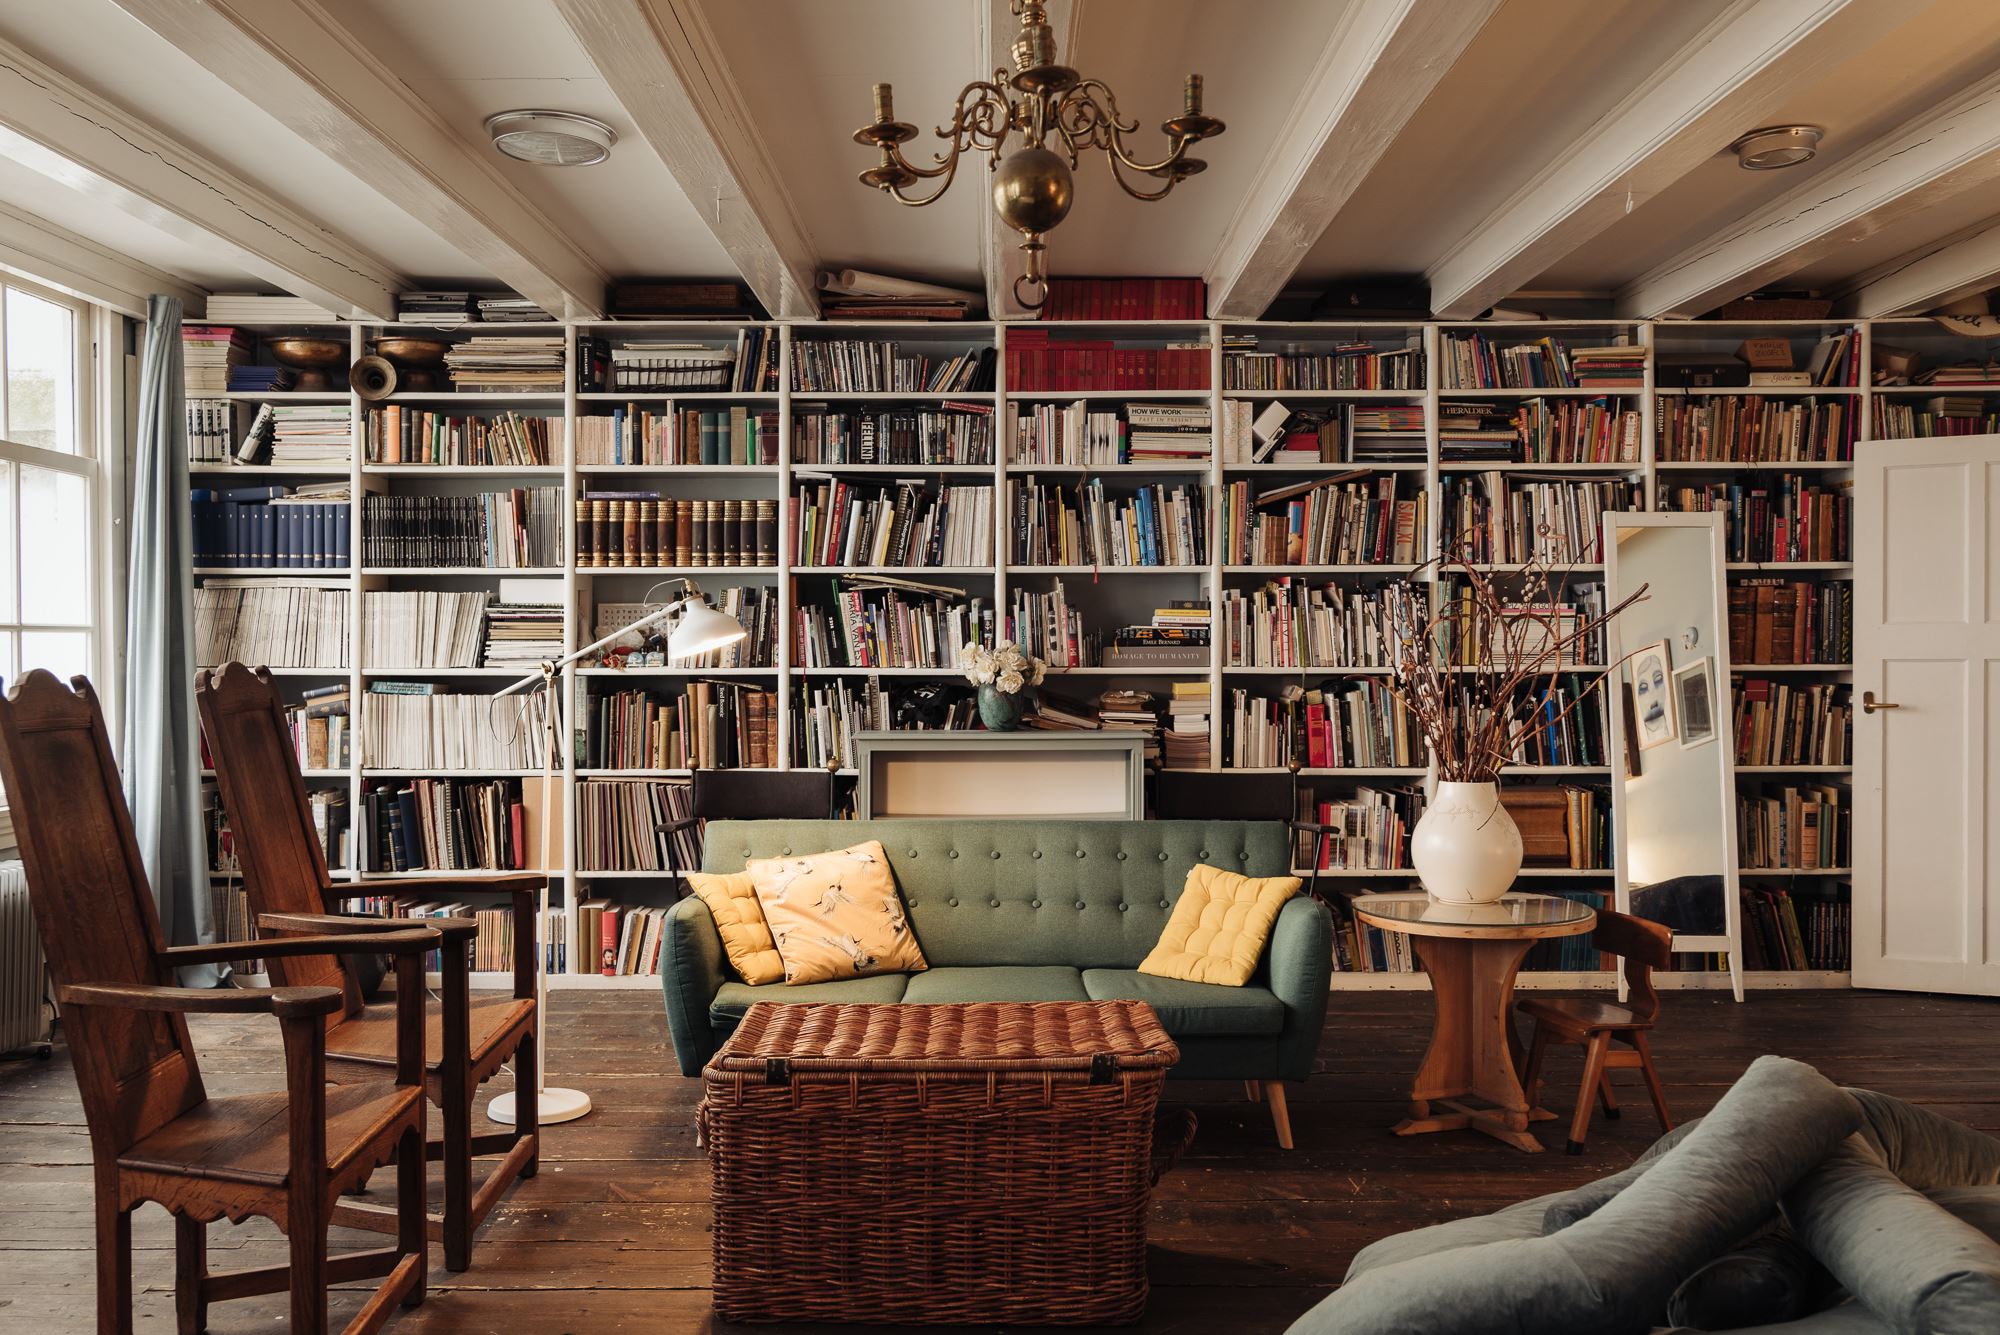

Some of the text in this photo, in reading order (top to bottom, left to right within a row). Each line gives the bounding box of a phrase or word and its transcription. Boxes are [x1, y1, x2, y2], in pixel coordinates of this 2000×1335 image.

[1446, 407, 1493, 415] HERALDIEK
[1657, 396, 1665, 433] AMSTERDAM
[861, 423, 874, 459] FELLINI
[898, 519, 910, 549] Photography
[847, 594, 857, 625] MARIA
[852, 628, 860, 648] VAN
[855, 650, 862, 660] ES
